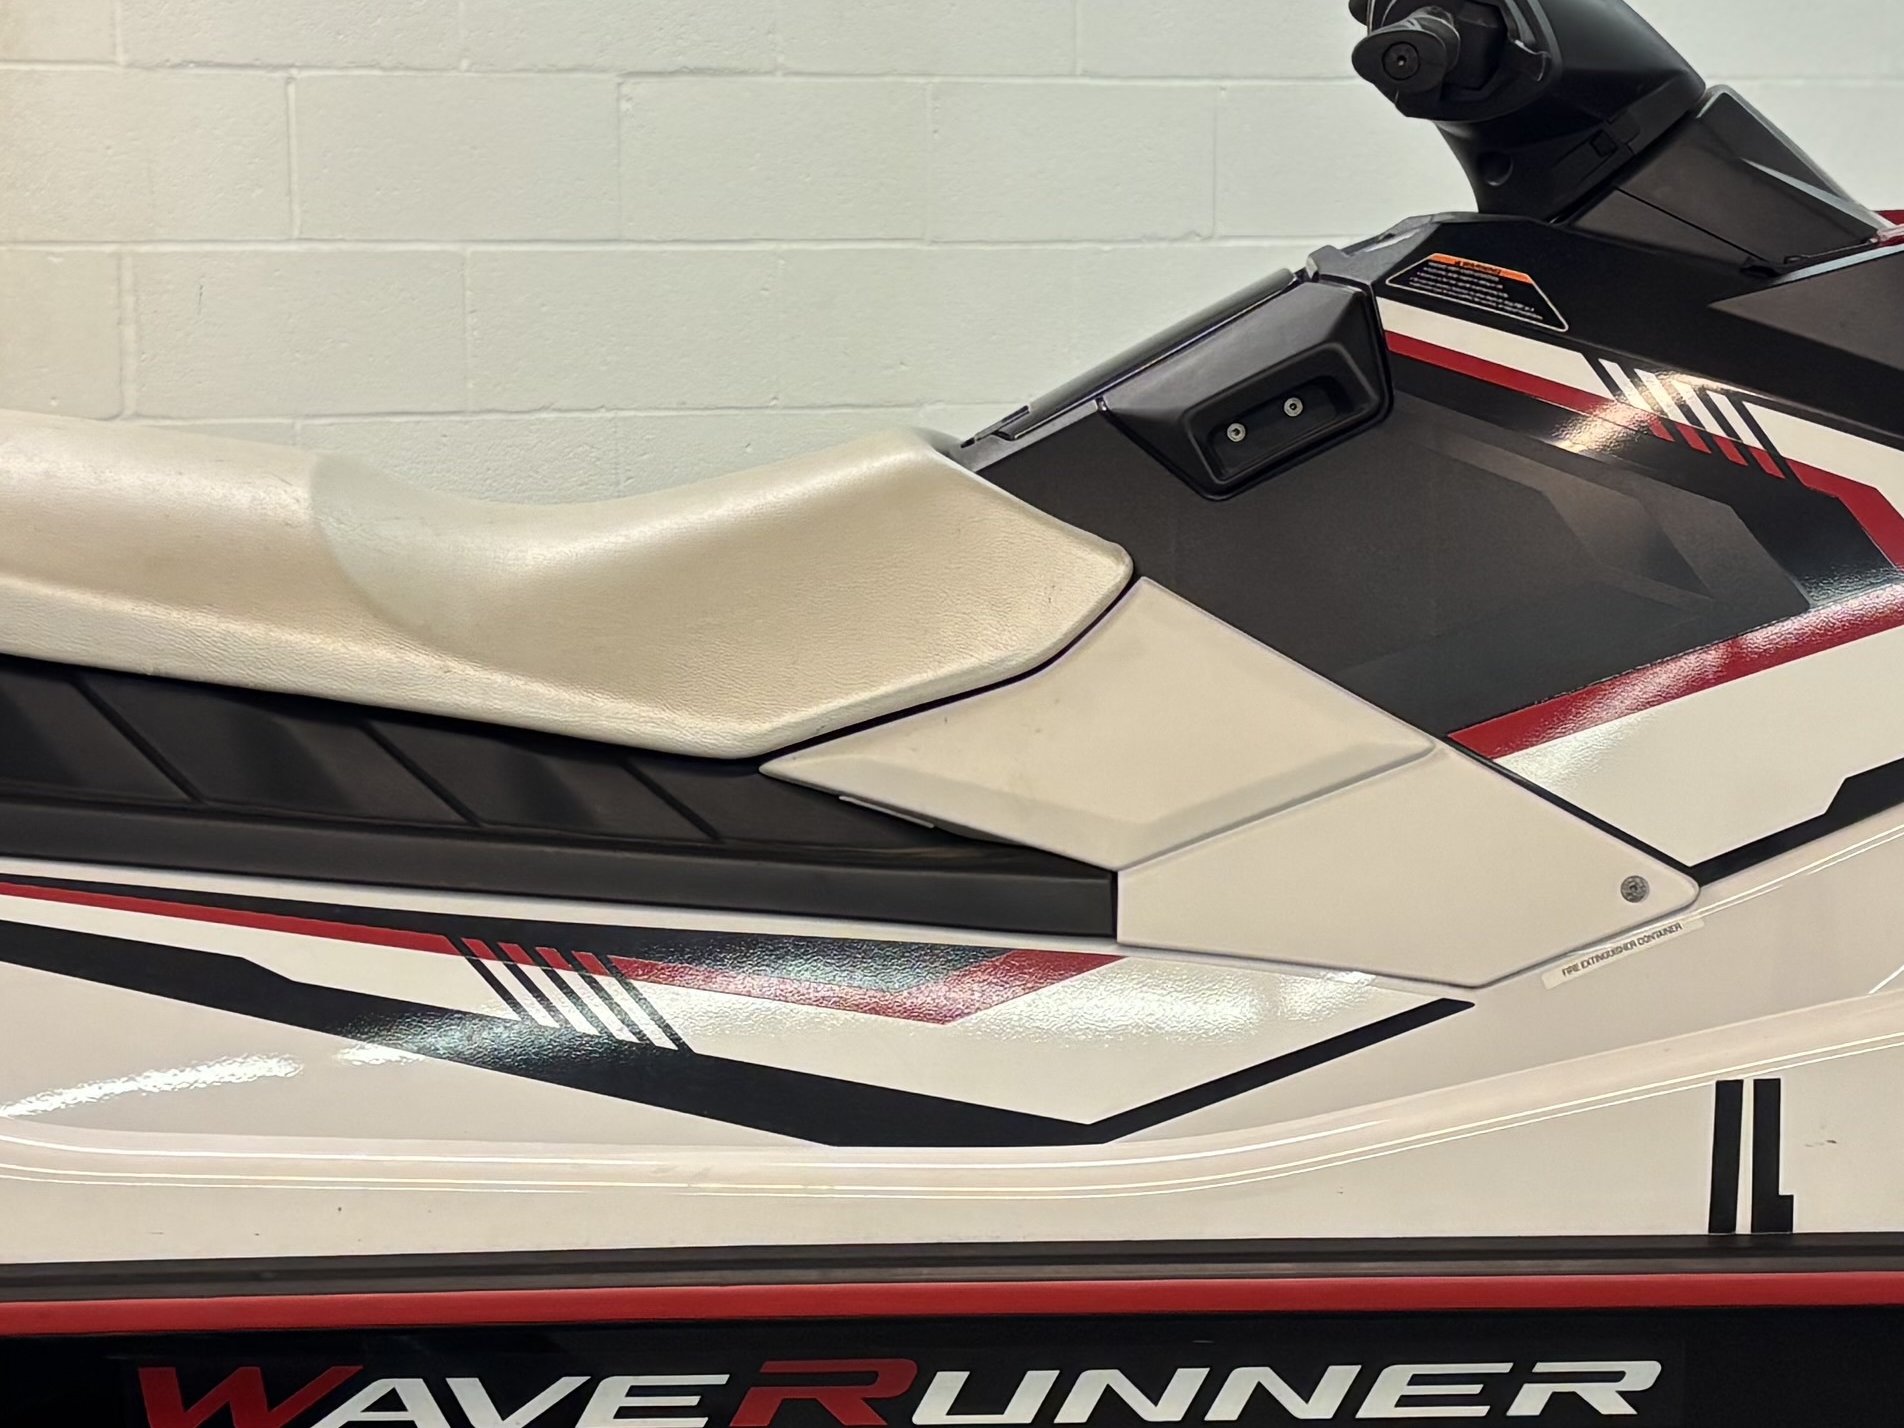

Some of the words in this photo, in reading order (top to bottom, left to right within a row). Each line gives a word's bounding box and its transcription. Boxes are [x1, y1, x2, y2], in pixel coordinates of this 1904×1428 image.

[1561, 962, 1582, 977] FIRE
[1637, 922, 1684, 946] CONTAINER
[1708, 1078, 1795, 1234] IL
